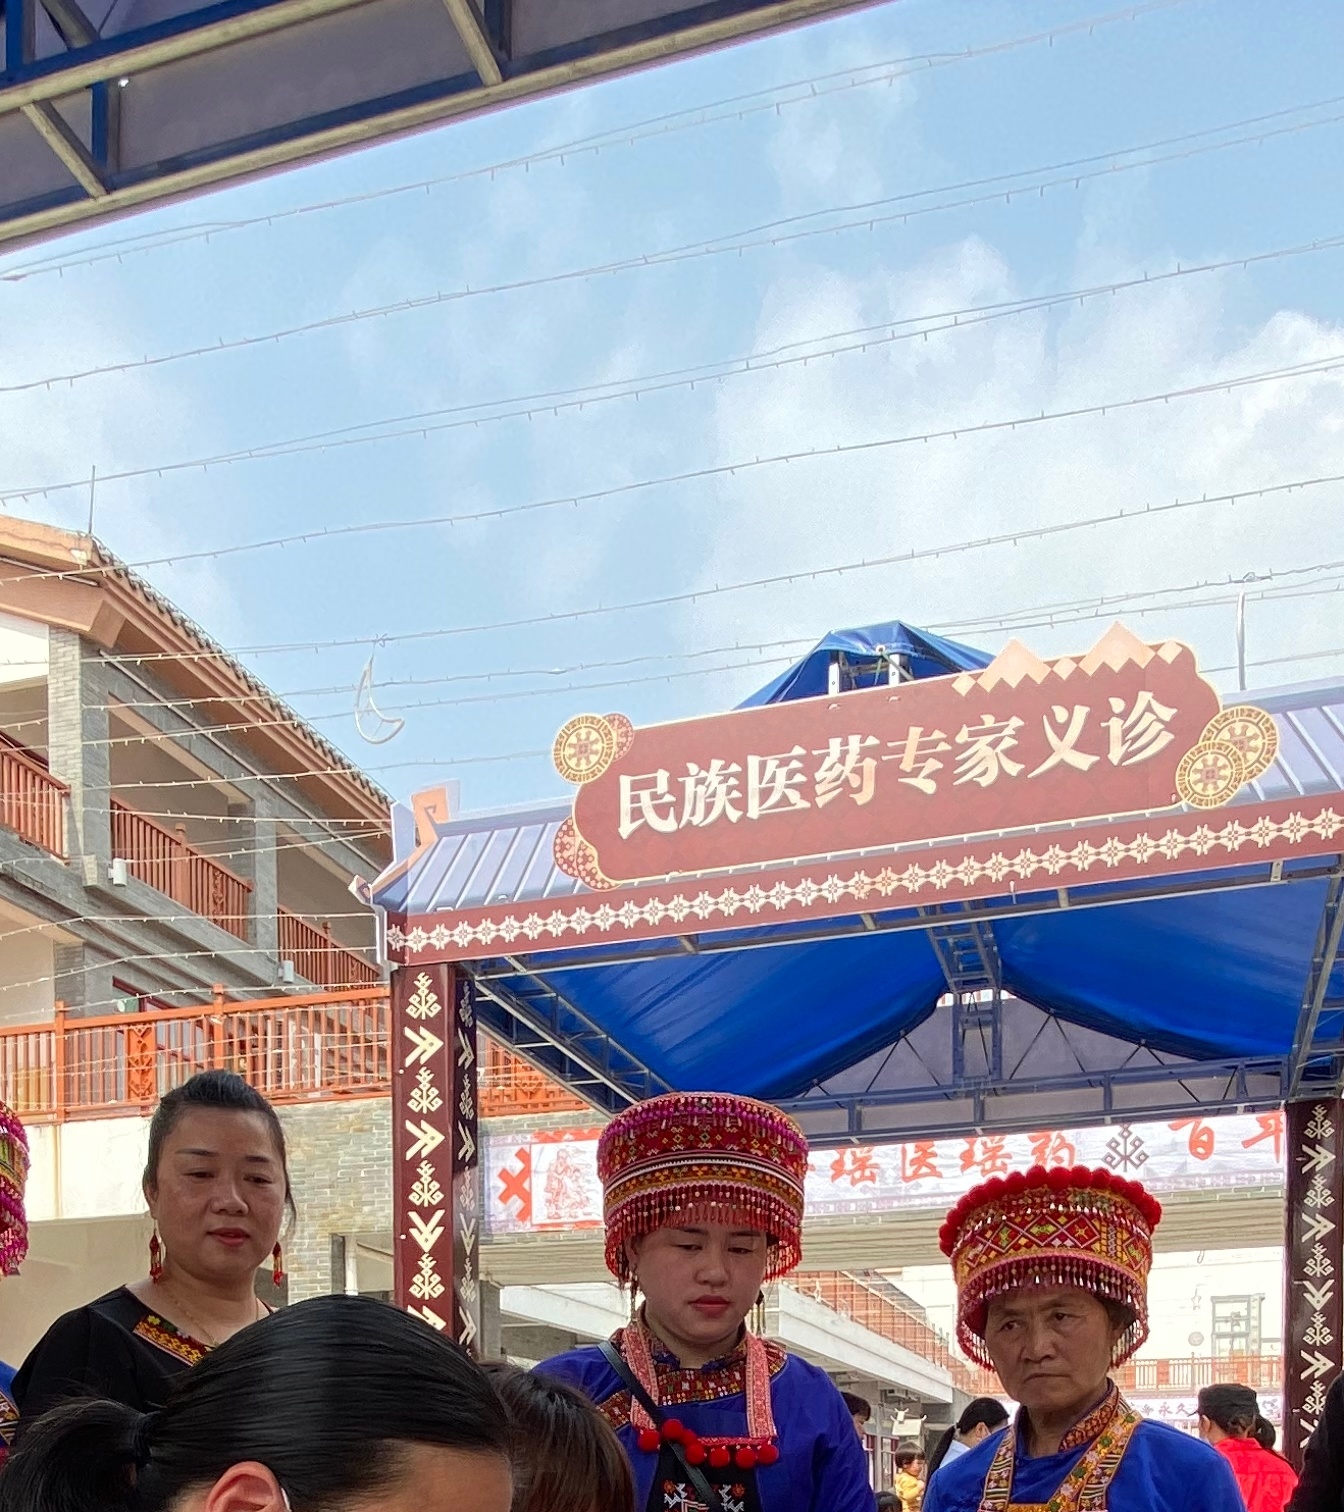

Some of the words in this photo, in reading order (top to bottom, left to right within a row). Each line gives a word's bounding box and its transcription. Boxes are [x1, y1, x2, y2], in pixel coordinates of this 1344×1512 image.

[618, 691, 1177, 840] 民族医药专家义诊
